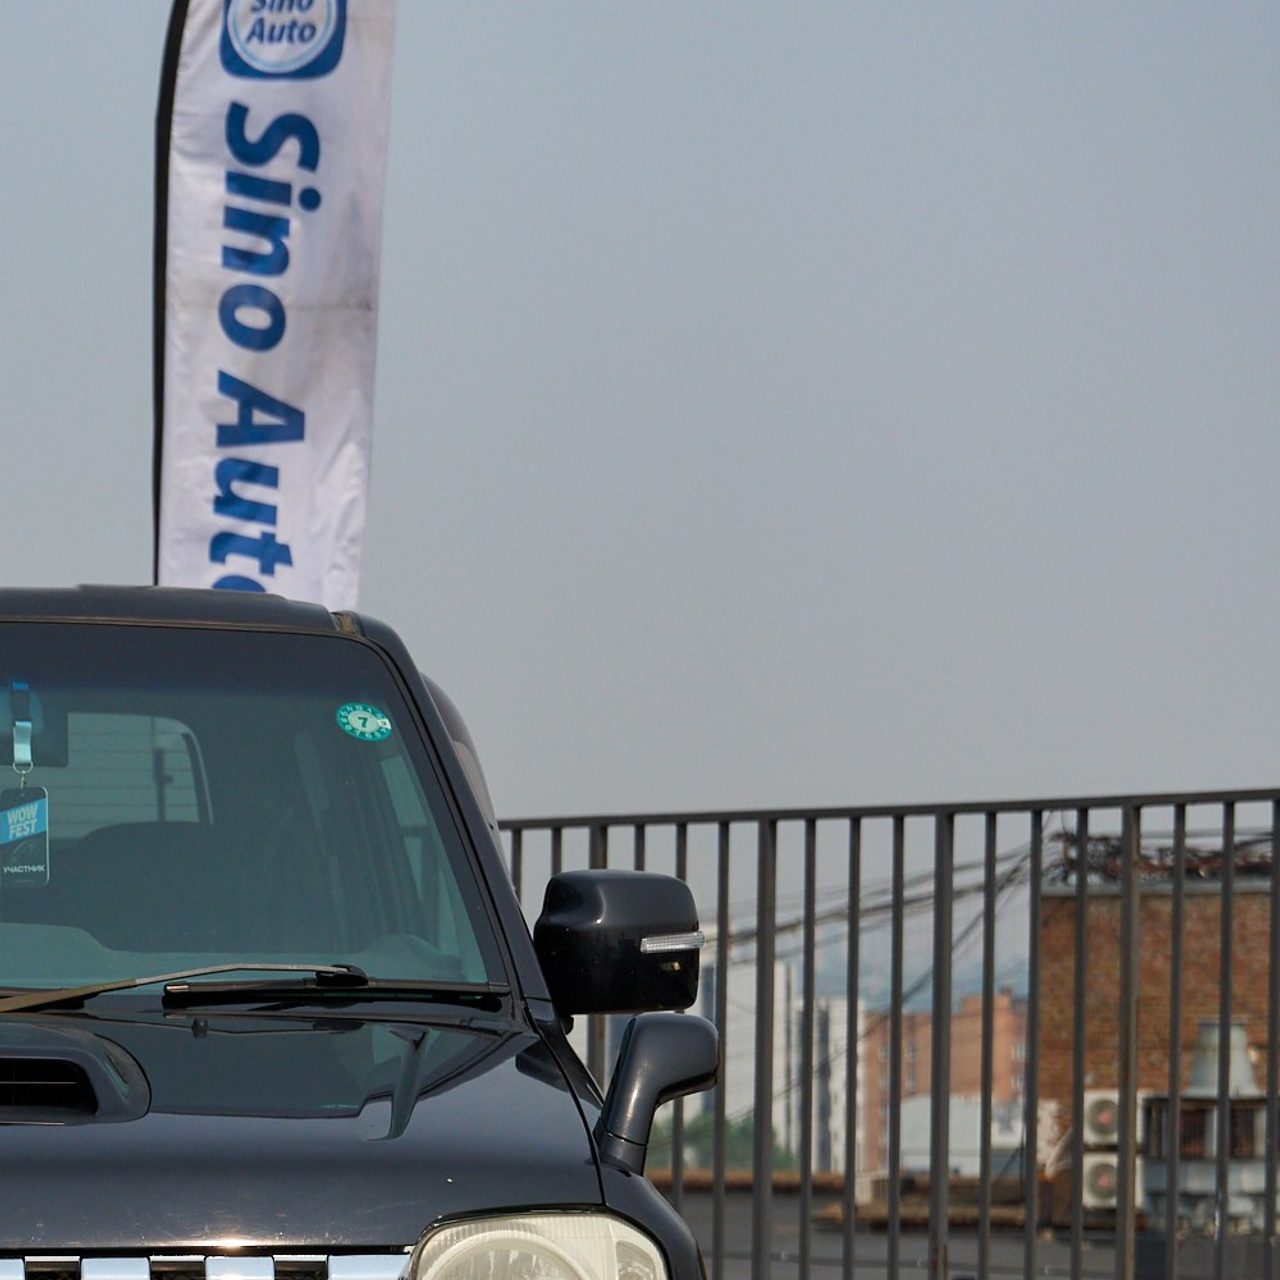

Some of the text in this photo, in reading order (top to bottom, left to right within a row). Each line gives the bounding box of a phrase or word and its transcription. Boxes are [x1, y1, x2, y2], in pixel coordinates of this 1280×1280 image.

[245, 17, 316, 43] Auto
[210, 101, 321, 593] Sino Aut
[357, 716, 369, 729] 7
[7, 802, 39, 825] WOW
[8, 819, 38, 840] FEST
[2, 864, 46, 874] УЧАСТНИК
